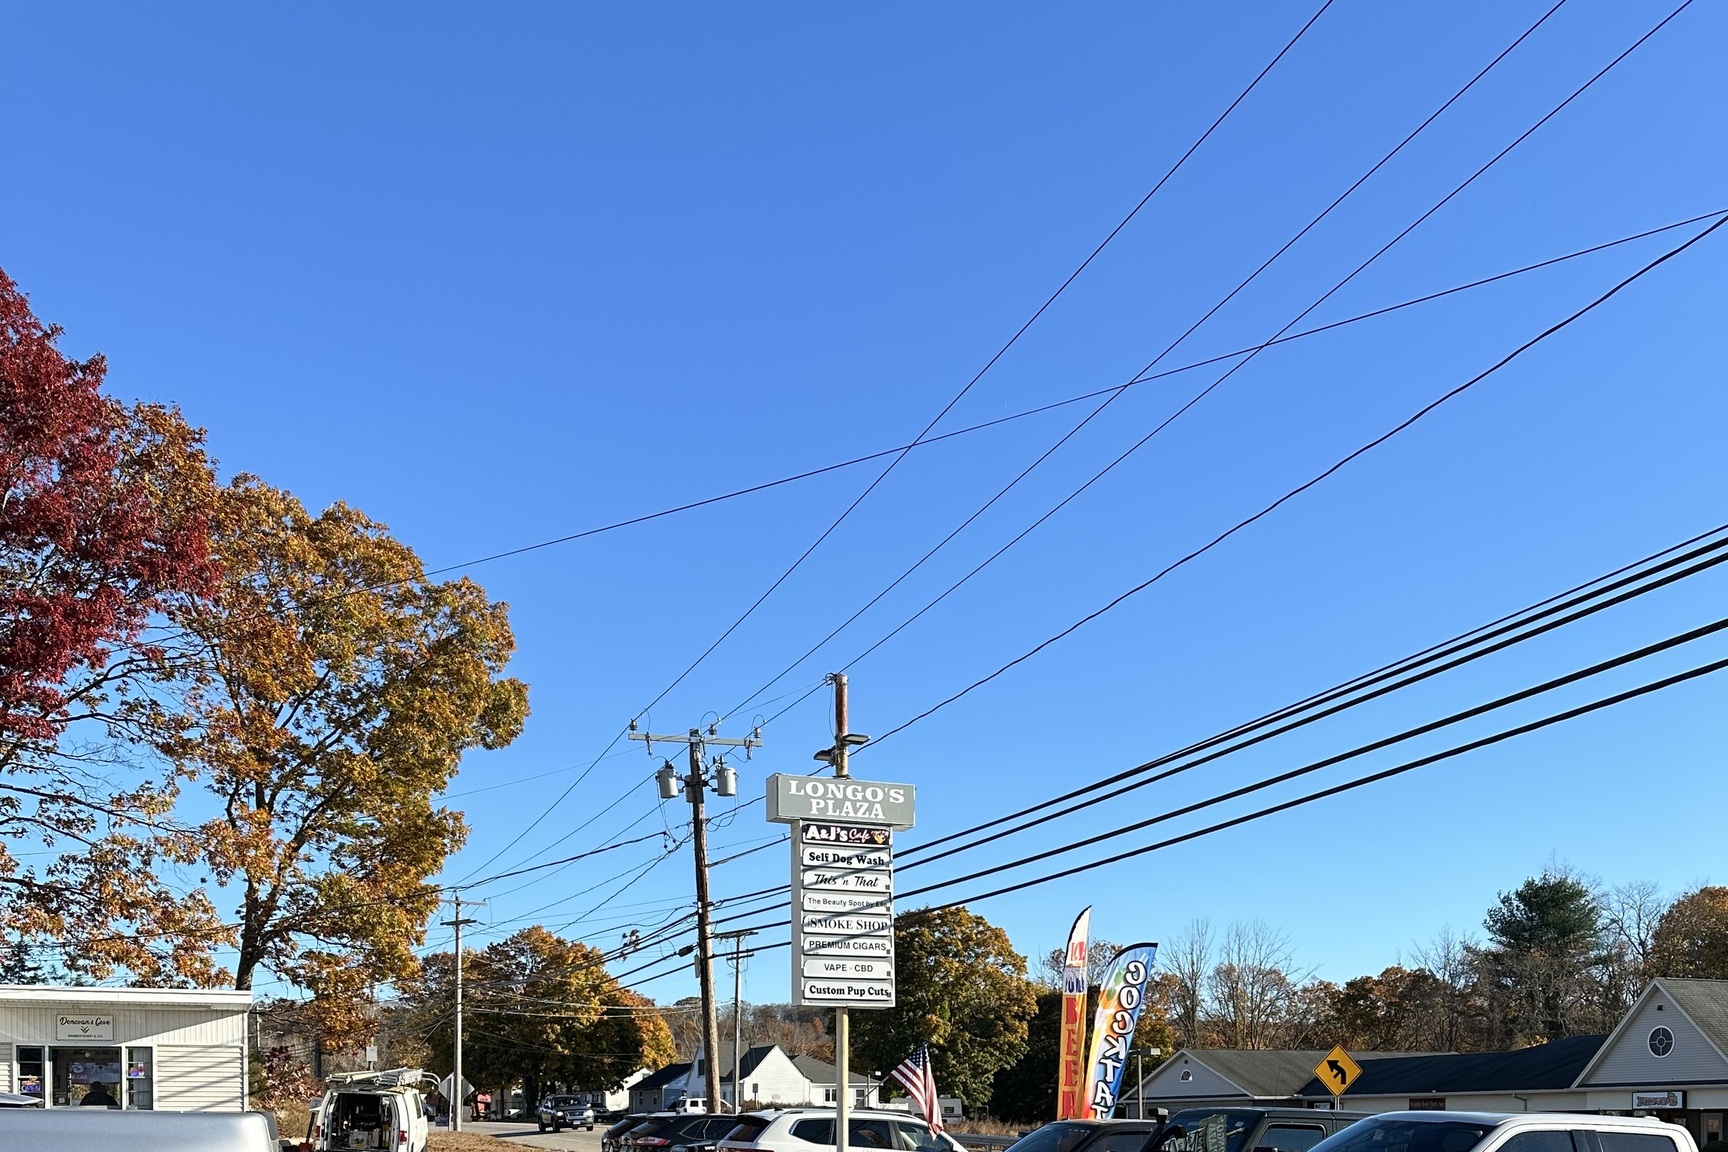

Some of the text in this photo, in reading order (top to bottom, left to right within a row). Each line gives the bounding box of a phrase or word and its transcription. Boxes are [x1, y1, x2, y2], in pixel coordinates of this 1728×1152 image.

[788, 780, 905, 804] LONGO'S
[809, 798, 886, 819] PLAZA
[806, 825, 848, 841] A&J's
[808, 852, 885, 866] Self Dog Wash
[814, 873, 837, 886] This
[854, 875, 881, 888] That
[822, 898, 847, 907] Beauty
[848, 899, 865, 907] Spot
[856, 919, 888, 931] SHOP
[809, 940, 887, 951] PREMIUM CIGARS
[824, 963, 874, 973] VAPE CBD
[809, 984, 889, 998] Custom Pup Cuts
